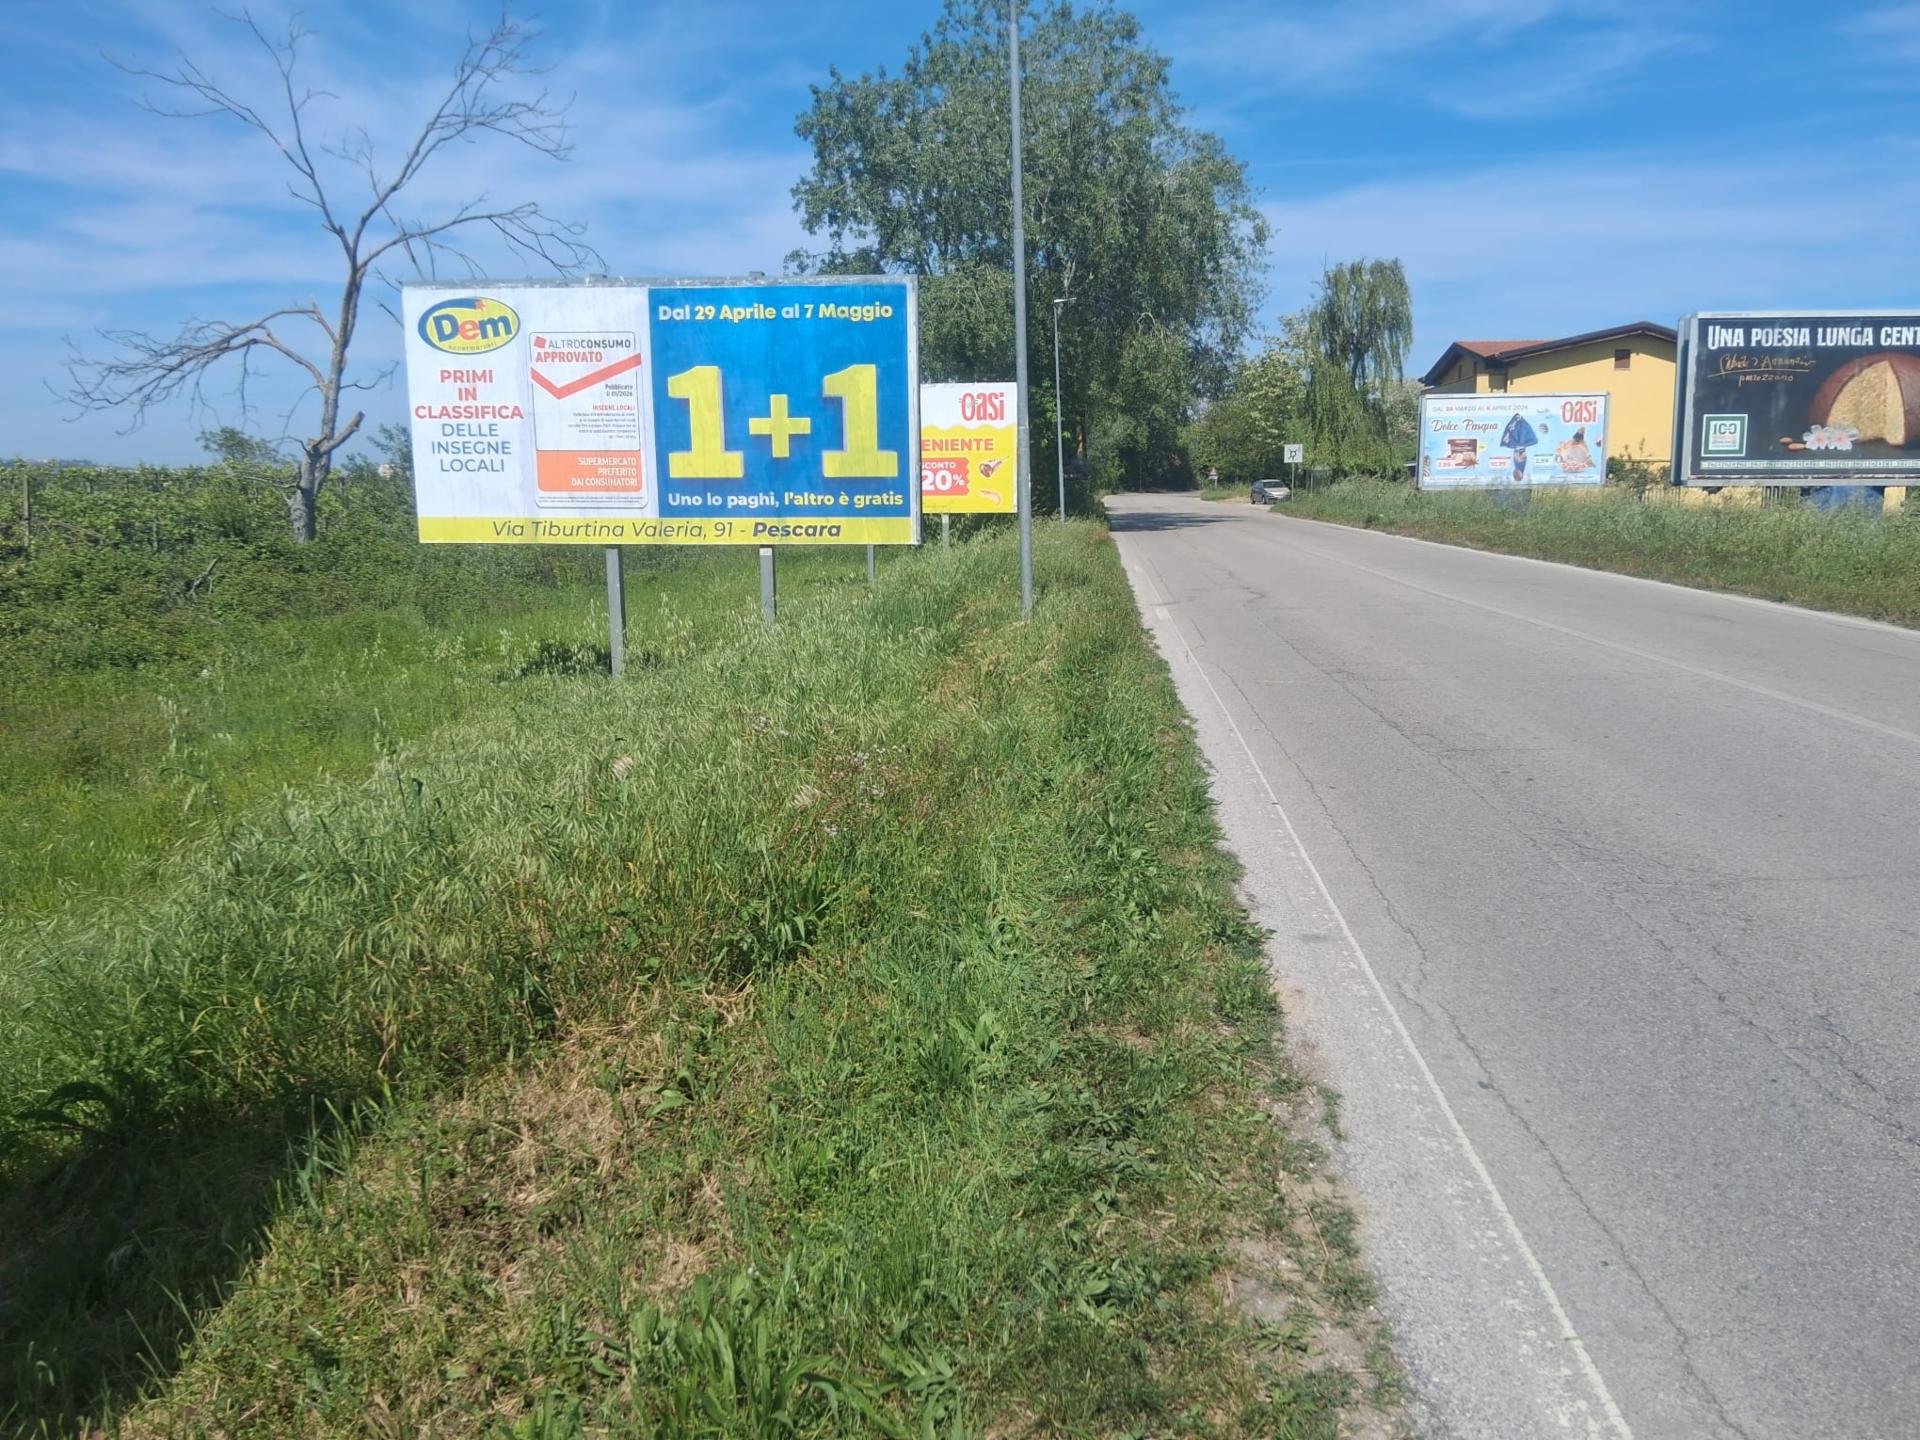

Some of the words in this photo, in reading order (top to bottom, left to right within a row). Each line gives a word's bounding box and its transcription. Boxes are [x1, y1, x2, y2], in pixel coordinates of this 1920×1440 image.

[658, 306, 690, 321] Dal
[694, 306, 716, 320] 29
[719, 304, 777, 324] Aprile
[781, 304, 800, 320] al
[804, 304, 815, 319] 7
[818, 301, 893, 322] Maggio
[433, 314, 512, 342] Dem
[548, 339, 631, 349] ALTROCONSUMO
[535, 351, 603, 363] APPROVATO
[440, 369, 494, 384] PRIMI
[458, 387, 478, 401] IN
[415, 406, 524, 420] CLASSIFICA
[441, 423, 498, 437] DELLE
[1431, 419, 1459, 432] Dolce
[1462, 419, 1499, 433] Pasqua
[432, 441, 511, 455] INSEGNE
[440, 458, 505, 472] LOCALI
[577, 457, 637, 466] SUPERMERCATO
[597, 467, 637, 476] PREFERITO
[571, 478, 584, 486] DAI
[585, 477, 638, 486] CONSUMATORI
[668, 492, 703, 507] Uno
[707, 492, 723, 507] lo
[727, 491, 780, 510] paghi,
[784, 492, 834, 506] l'altro
[839, 492, 850, 506] è
[853, 491, 904, 509] gratis
[493, 521, 525, 537] Via
[531, 521, 624, 537] Tiburtina
[632, 521, 707, 540] Valeria,
[713, 521, 734, 537] 91
[752, 521, 841, 538] Pescara
